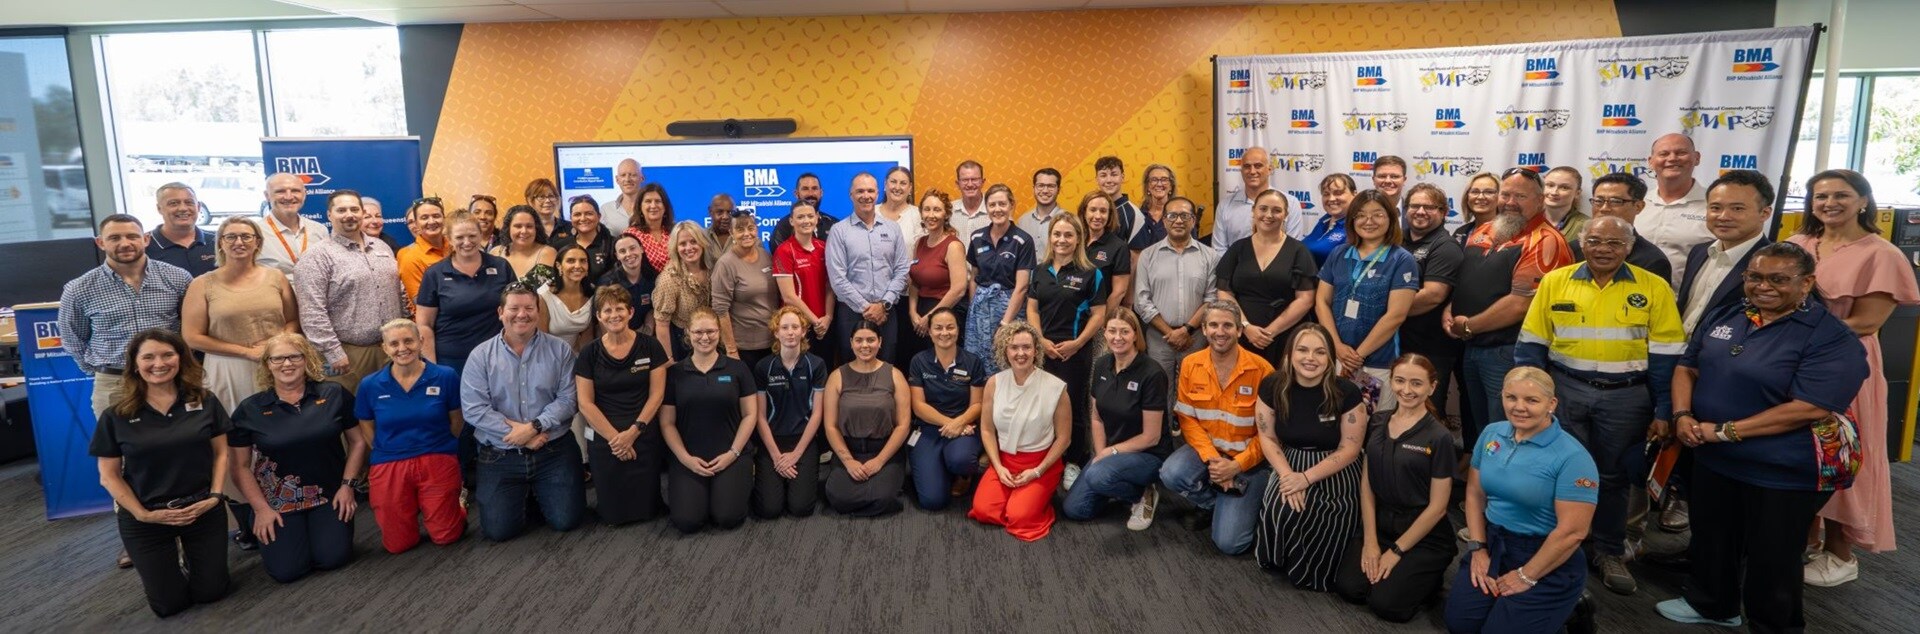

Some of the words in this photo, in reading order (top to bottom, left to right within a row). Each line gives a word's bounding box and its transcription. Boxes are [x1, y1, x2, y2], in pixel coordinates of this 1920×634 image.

[1734, 47, 1773, 62] BMA
[1526, 58, 1556, 71] BMA
[1230, 69, 1250, 80] BMA
[1358, 66, 1382, 78] BMA
[1292, 110, 1315, 120] BMA
[1436, 108, 1461, 120] BMA
[1603, 104, 1636, 118] BMA
[1353, 152, 1378, 162] BMA
[1518, 153, 1545, 165] BMA
[1720, 155, 1757, 169] BMA
[278, 158, 319, 174] BMA
[744, 168, 779, 185] BMA
[37, 323, 60, 338] BM
